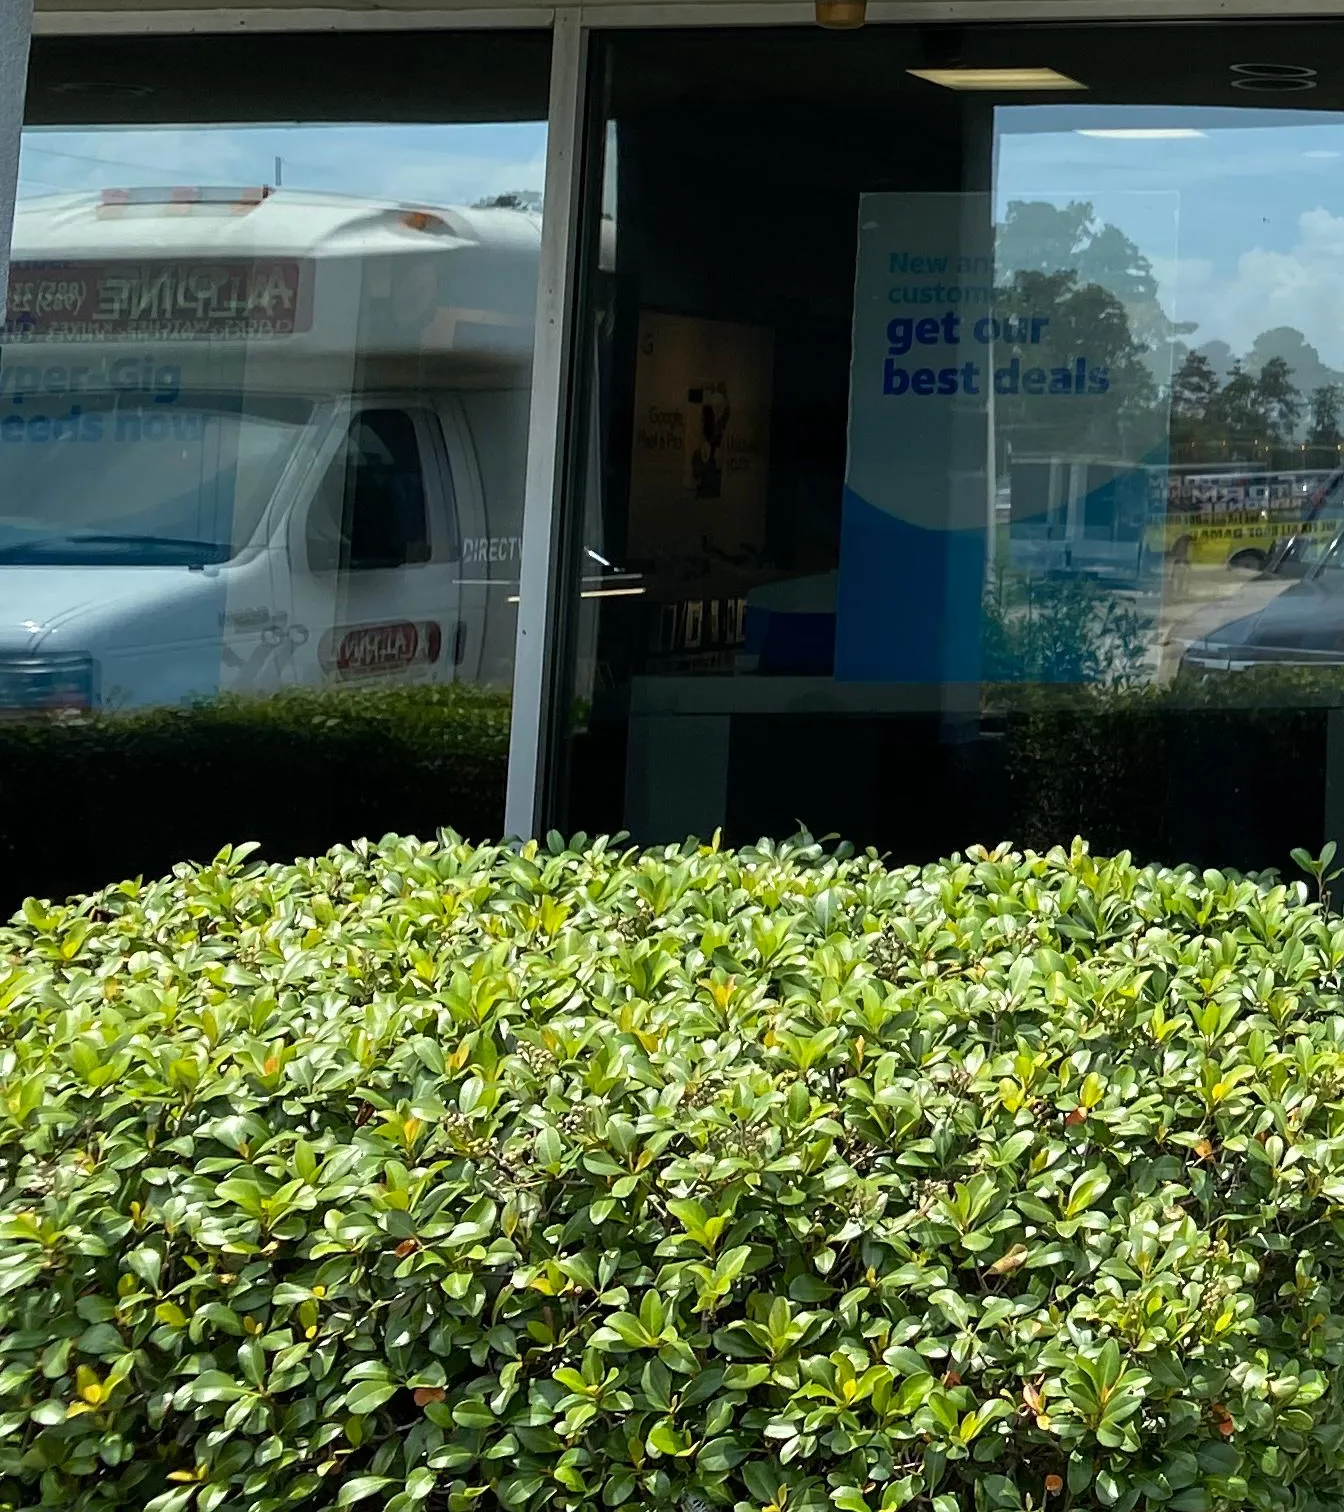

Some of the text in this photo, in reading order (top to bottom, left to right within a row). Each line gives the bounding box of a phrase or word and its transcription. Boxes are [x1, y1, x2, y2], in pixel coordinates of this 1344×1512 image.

[888, 251, 996, 275] New an
[886, 311, 1050, 355] get our
[883, 357, 1111, 396] best deals
